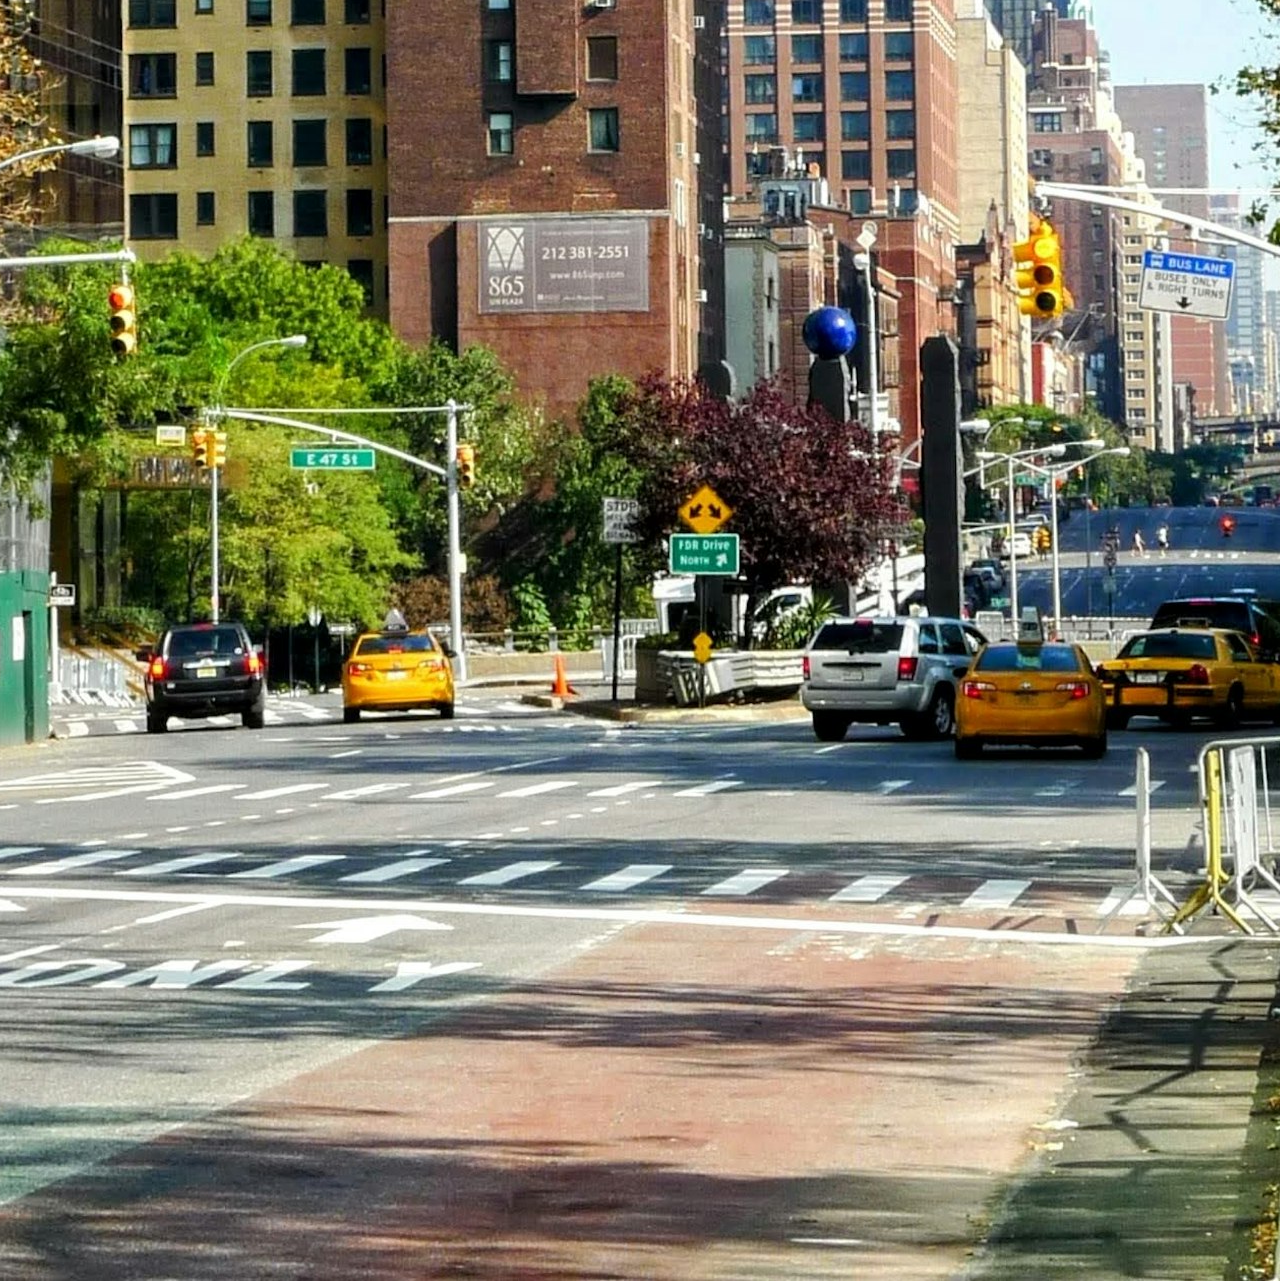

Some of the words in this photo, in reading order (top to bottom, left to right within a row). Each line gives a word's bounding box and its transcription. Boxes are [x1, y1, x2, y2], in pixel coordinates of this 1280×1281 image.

[541, 247, 566, 260] 212
[569, 245, 629, 259] 381-2551
[1168, 257, 1192, 270] BUS
[1195, 261, 1227, 274] LANE
[488, 275, 524, 297] 865
[1154, 271, 1187, 284] BUSES
[1192, 276, 1218, 287] ONLY
[1158, 283, 1187, 294] RIGHT
[1192, 286, 1225, 300] TURNS
[502, 297, 523, 305] PLAZA
[307, 454, 316, 465] E
[319, 454, 337, 465] 47
[342, 454, 358, 465] St
[607, 501, 637, 513] STOP
[678, 539, 699, 551] FDR
[703, 539, 730, 551] Drive
